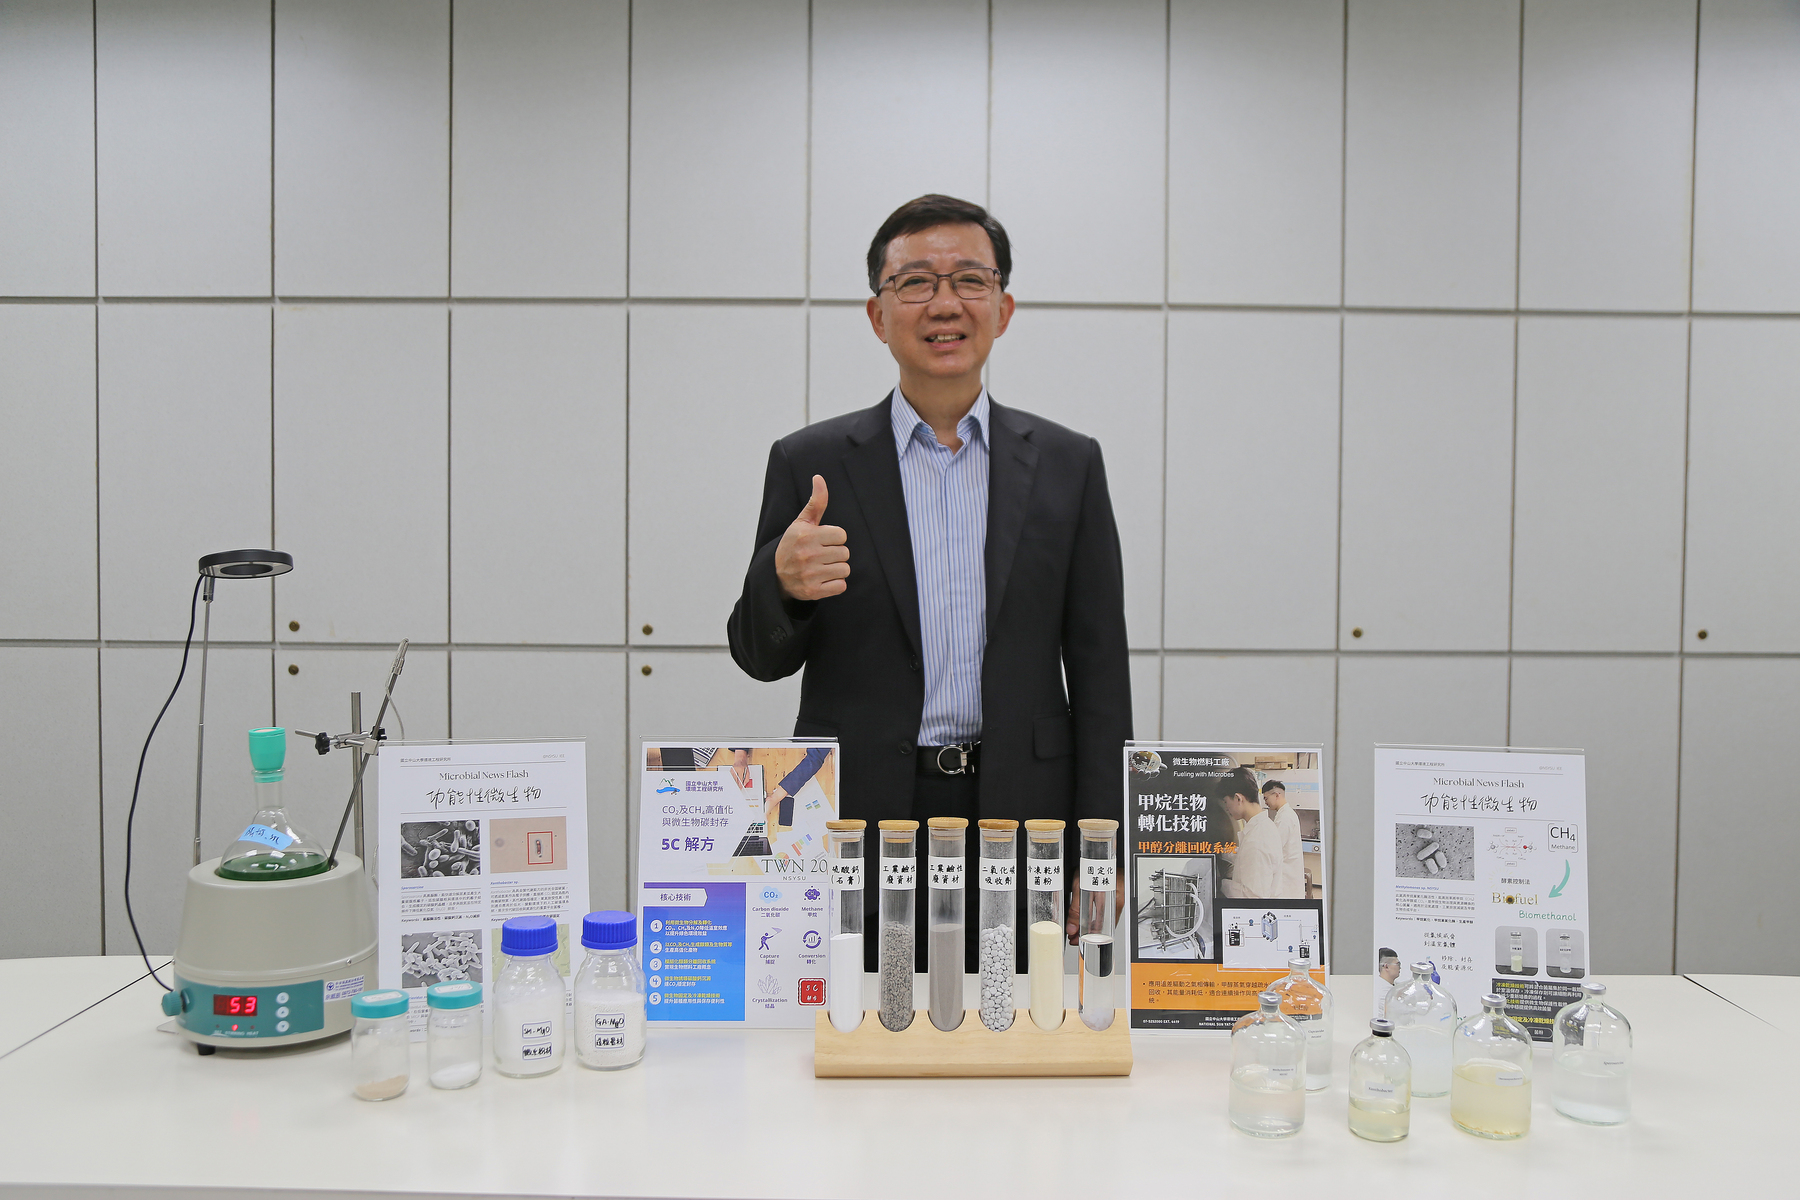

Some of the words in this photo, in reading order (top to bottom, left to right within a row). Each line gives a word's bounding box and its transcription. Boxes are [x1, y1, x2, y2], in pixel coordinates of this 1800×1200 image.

[1172, 757, 1230, 767] 微生物燃料工廠
[439, 770, 481, 781] Microbial
[482, 770, 504, 779] News
[505, 769, 529, 779] Flash
[1433, 777, 1475, 787] Microbial
[1476, 778, 1499, 787] News
[1501, 779, 1525, 789] Flash
[426, 786, 541, 809] 功能性微生物
[1138, 793, 1207, 811] 甲烷生物
[1421, 792, 1537, 813] 功能性微生物
[662, 817, 729, 827] 與微生物碳封存
[1138, 814, 1208, 832] 轉化技術
[661, 838, 680, 851] 5C
[684, 837, 715, 852] 解方
[1138, 841, 1237, 854] 甲醇分離回收系統
[761, 859, 804, 873] TWN
[1087, 866, 1114, 875] 固定化
[984, 876, 1012, 886] 吸收劑
[1033, 876, 1053, 886] 菌粉
[1091, 876, 1110, 886] 菌株
[1501, 877, 1531, 886] 酵素控制法
[660, 893, 692, 902] 核心技術
[1491, 892, 1538, 906] Biofuel
[1518, 910, 1577, 921] Biomethanol
[230, 996, 258, 1014] 53
